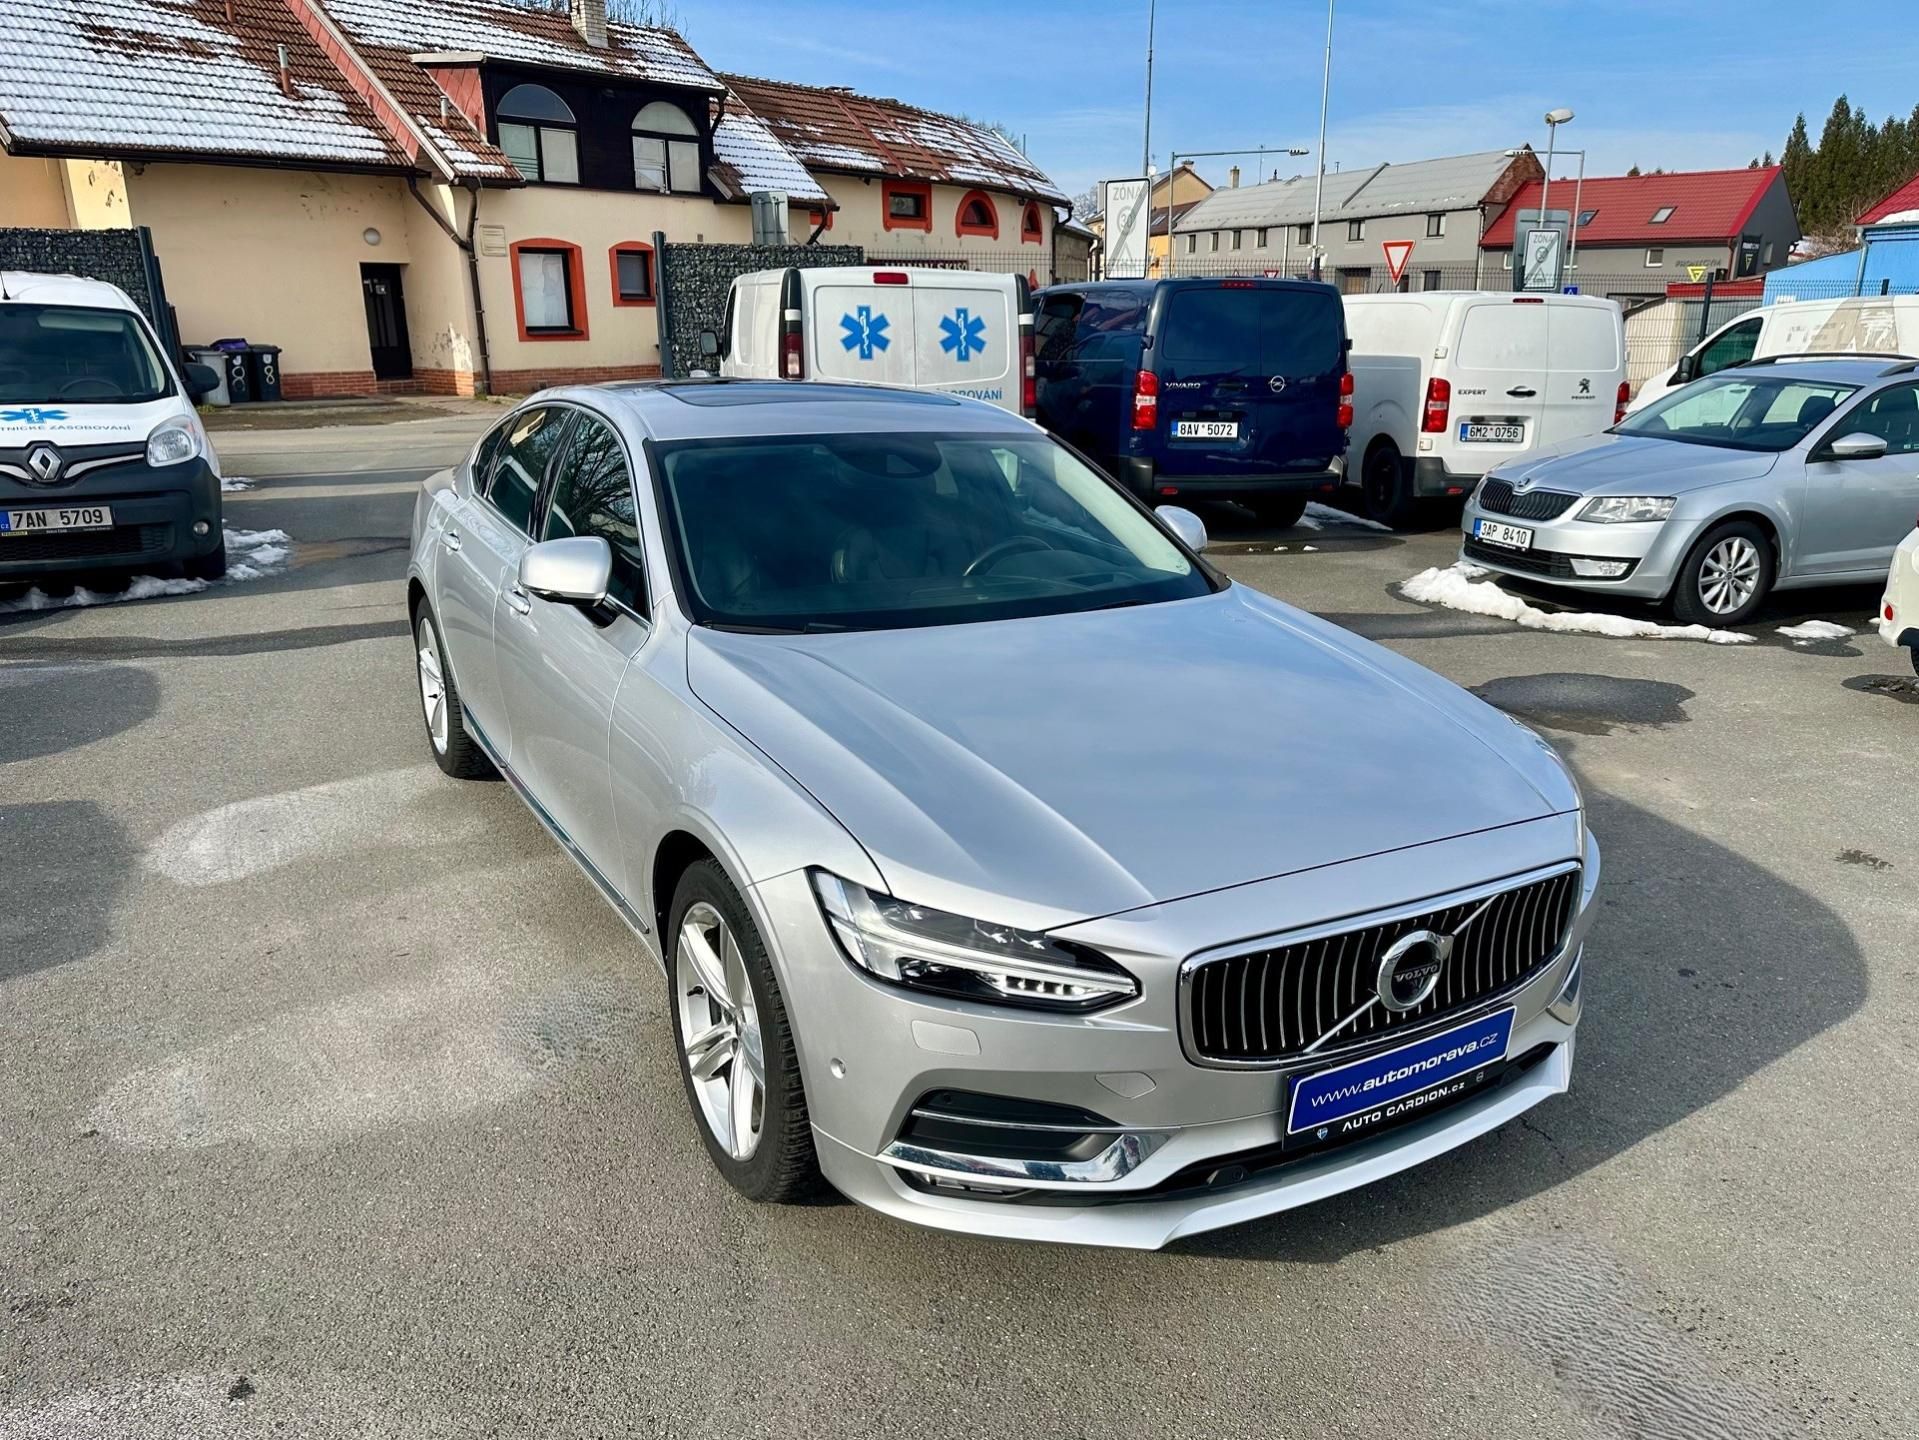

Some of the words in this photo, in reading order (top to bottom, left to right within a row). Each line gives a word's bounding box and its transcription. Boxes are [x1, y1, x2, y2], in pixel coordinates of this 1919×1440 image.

[1180, 424, 1200, 436] 8AV
[1207, 424, 1233, 436] 5072
[1469, 426, 1488, 438] 6M2
[1495, 427, 1519, 438] 0756
[13, 511, 48, 529] 7AN
[59, 509, 104, 526] 5709
[1481, 522, 1498, 537] 3AP
[1502, 527, 1527, 545] 8410
[1393, 964, 1438, 982] VOLVO
[1311, 1032, 1499, 1108] www.automorava.cz
[1342, 1111, 1382, 1132] AUTO
[1386, 1081, 1466, 1115] CARDION.cz
